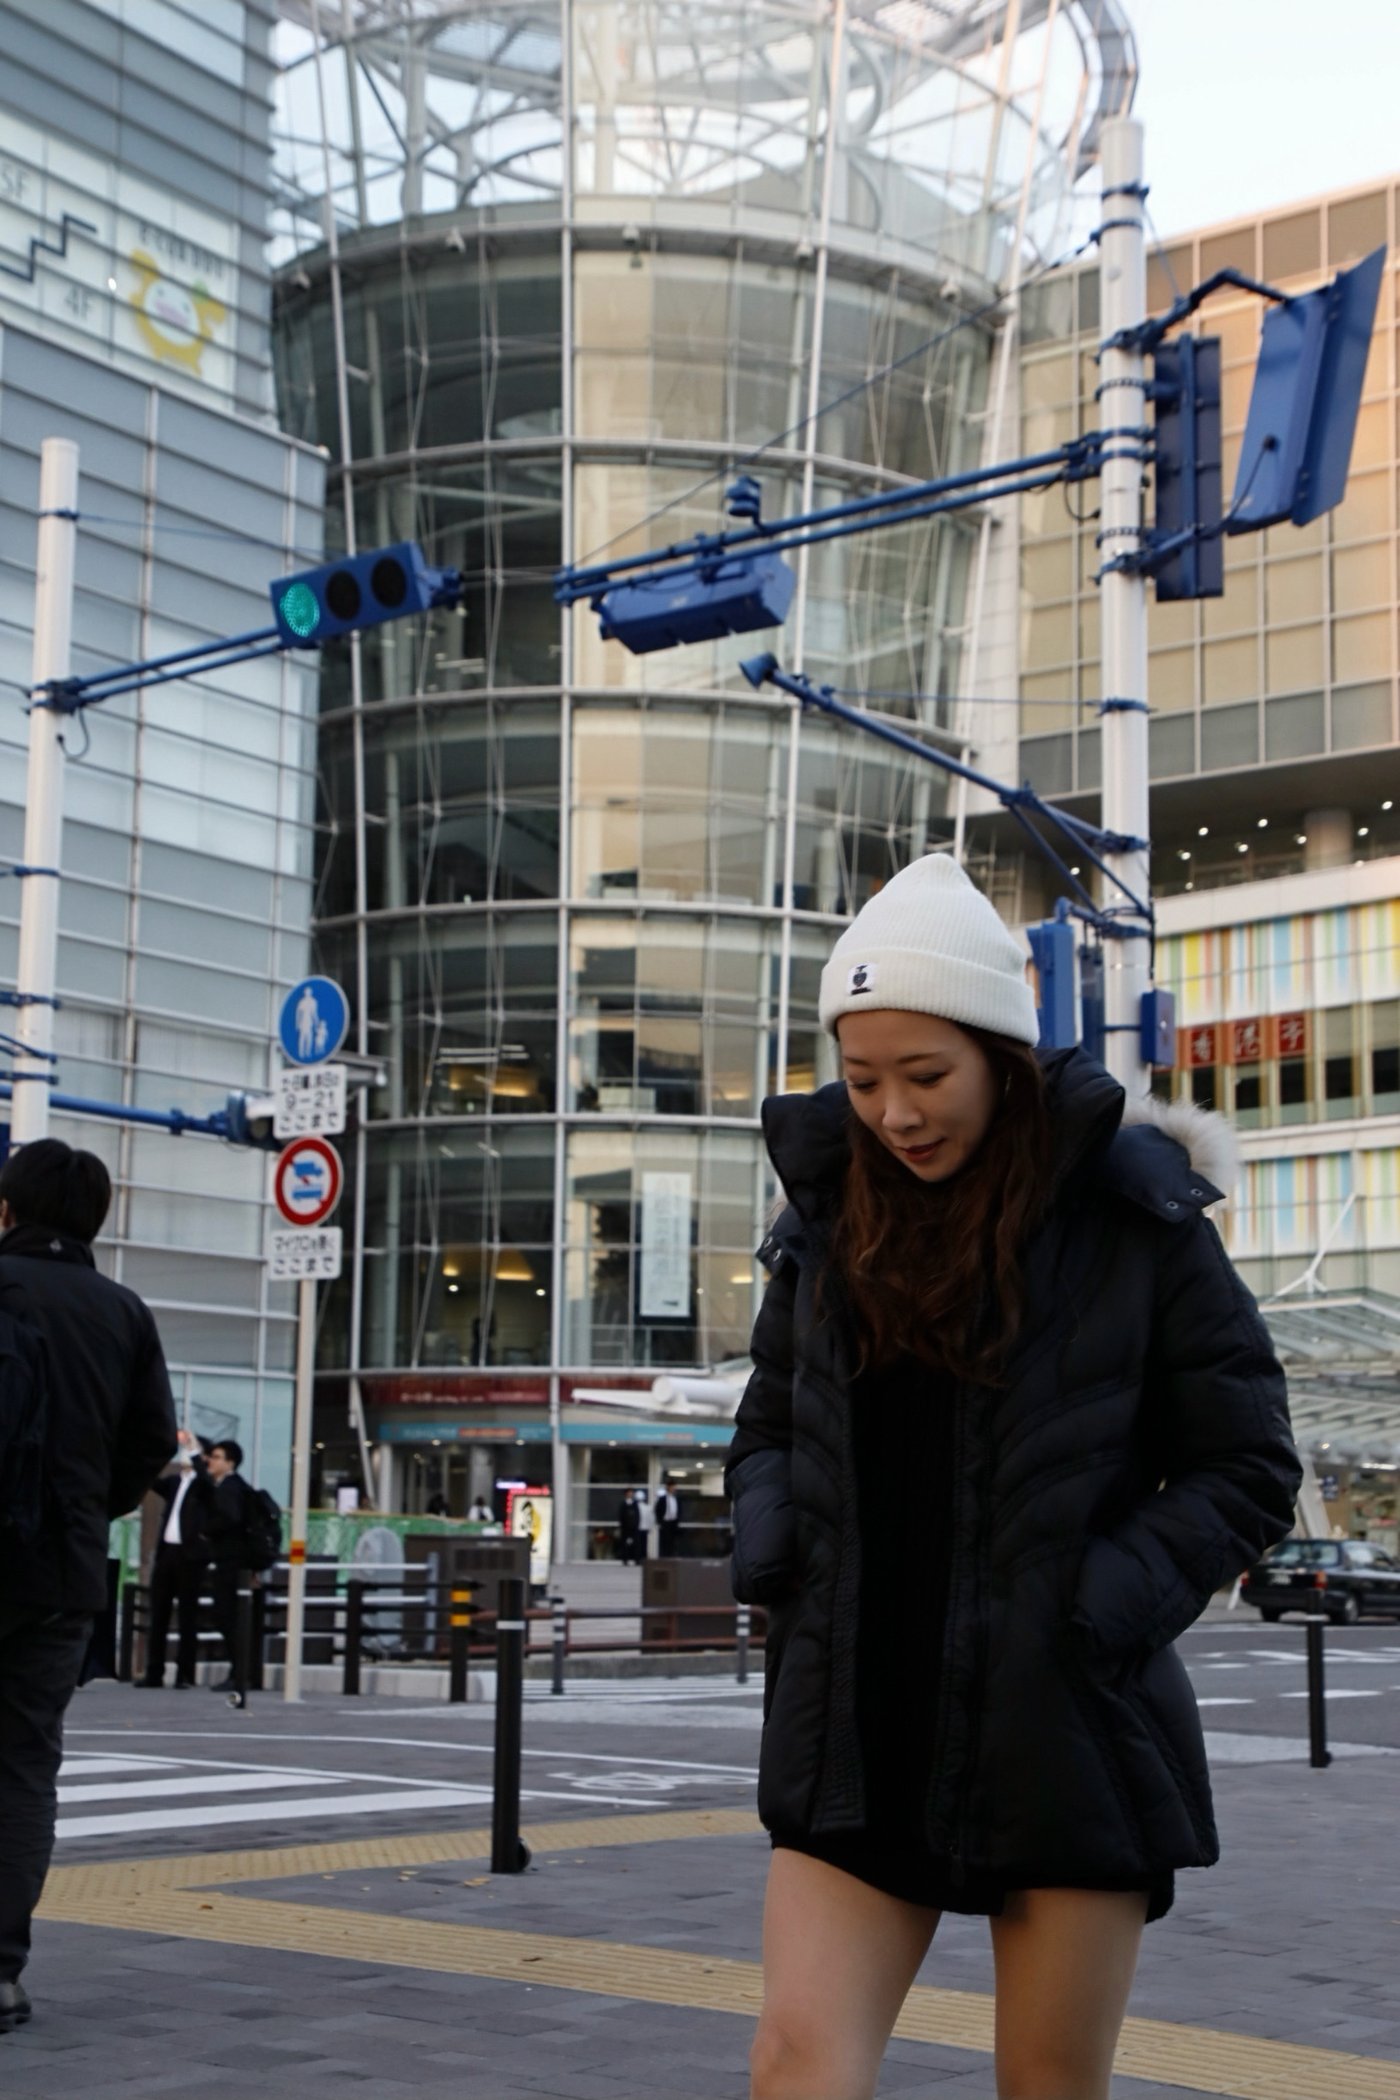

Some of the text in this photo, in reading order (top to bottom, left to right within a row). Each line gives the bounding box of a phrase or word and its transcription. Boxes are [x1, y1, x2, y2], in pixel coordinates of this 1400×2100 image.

[279, 1111, 338, 1132] ここまで
[273, 1256, 334, 1275] ここまで
